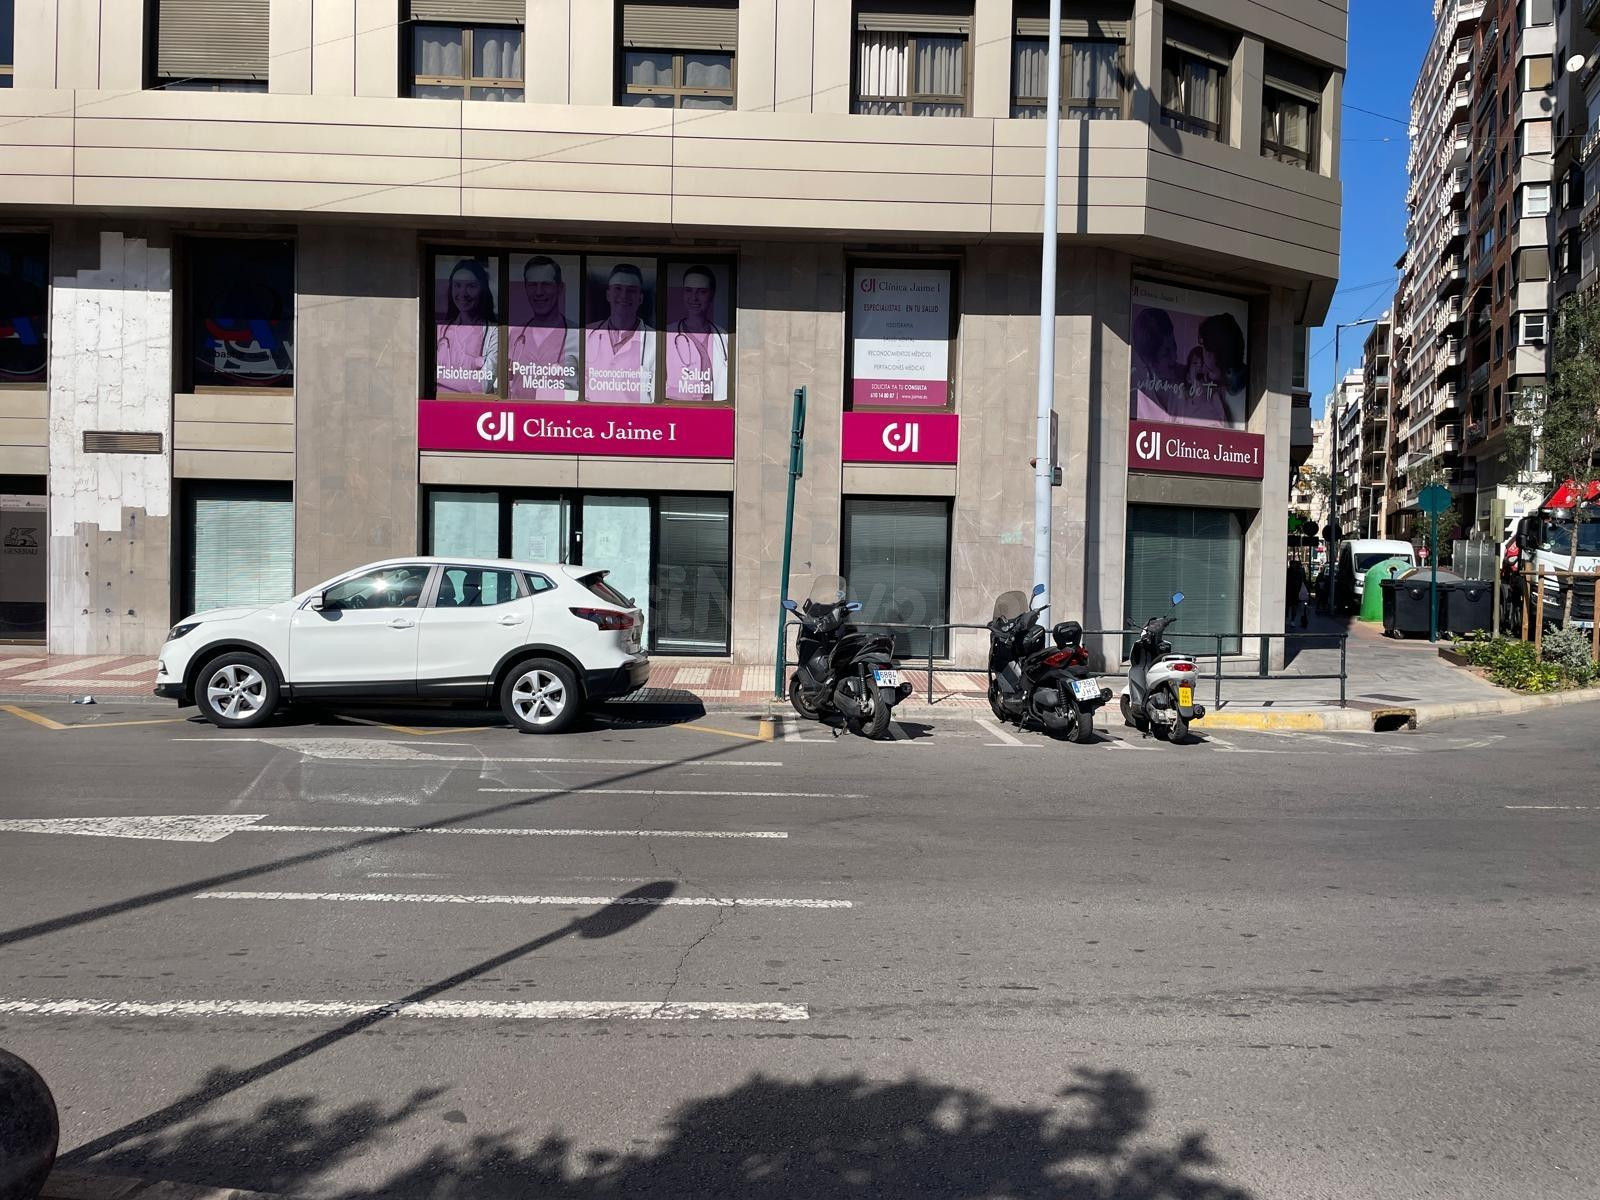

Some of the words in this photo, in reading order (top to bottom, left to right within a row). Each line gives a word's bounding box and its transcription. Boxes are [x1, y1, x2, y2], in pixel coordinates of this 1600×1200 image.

[910, 282, 936, 293] Jaime
[905, 304, 914, 312] EN
[921, 304, 939, 313] SALUD
[437, 365, 493, 382] Fisioterapia
[512, 361, 576, 377] Peritaciones
[588, 367, 652, 379] Reconocimientos
[681, 367, 711, 381] Salud
[522, 375, 565, 390] Médicas
[588, 378, 652, 392] Conductores
[678, 380, 713, 394] Mental
[522, 418, 595, 439] Clínica
[600, 421, 663, 441] Jaime
[668, 423, 676, 441] I
[1165, 438, 1210, 460] Clínica
[1213, 444, 1251, 464] Jaime
[1253, 447, 1259, 465] I
